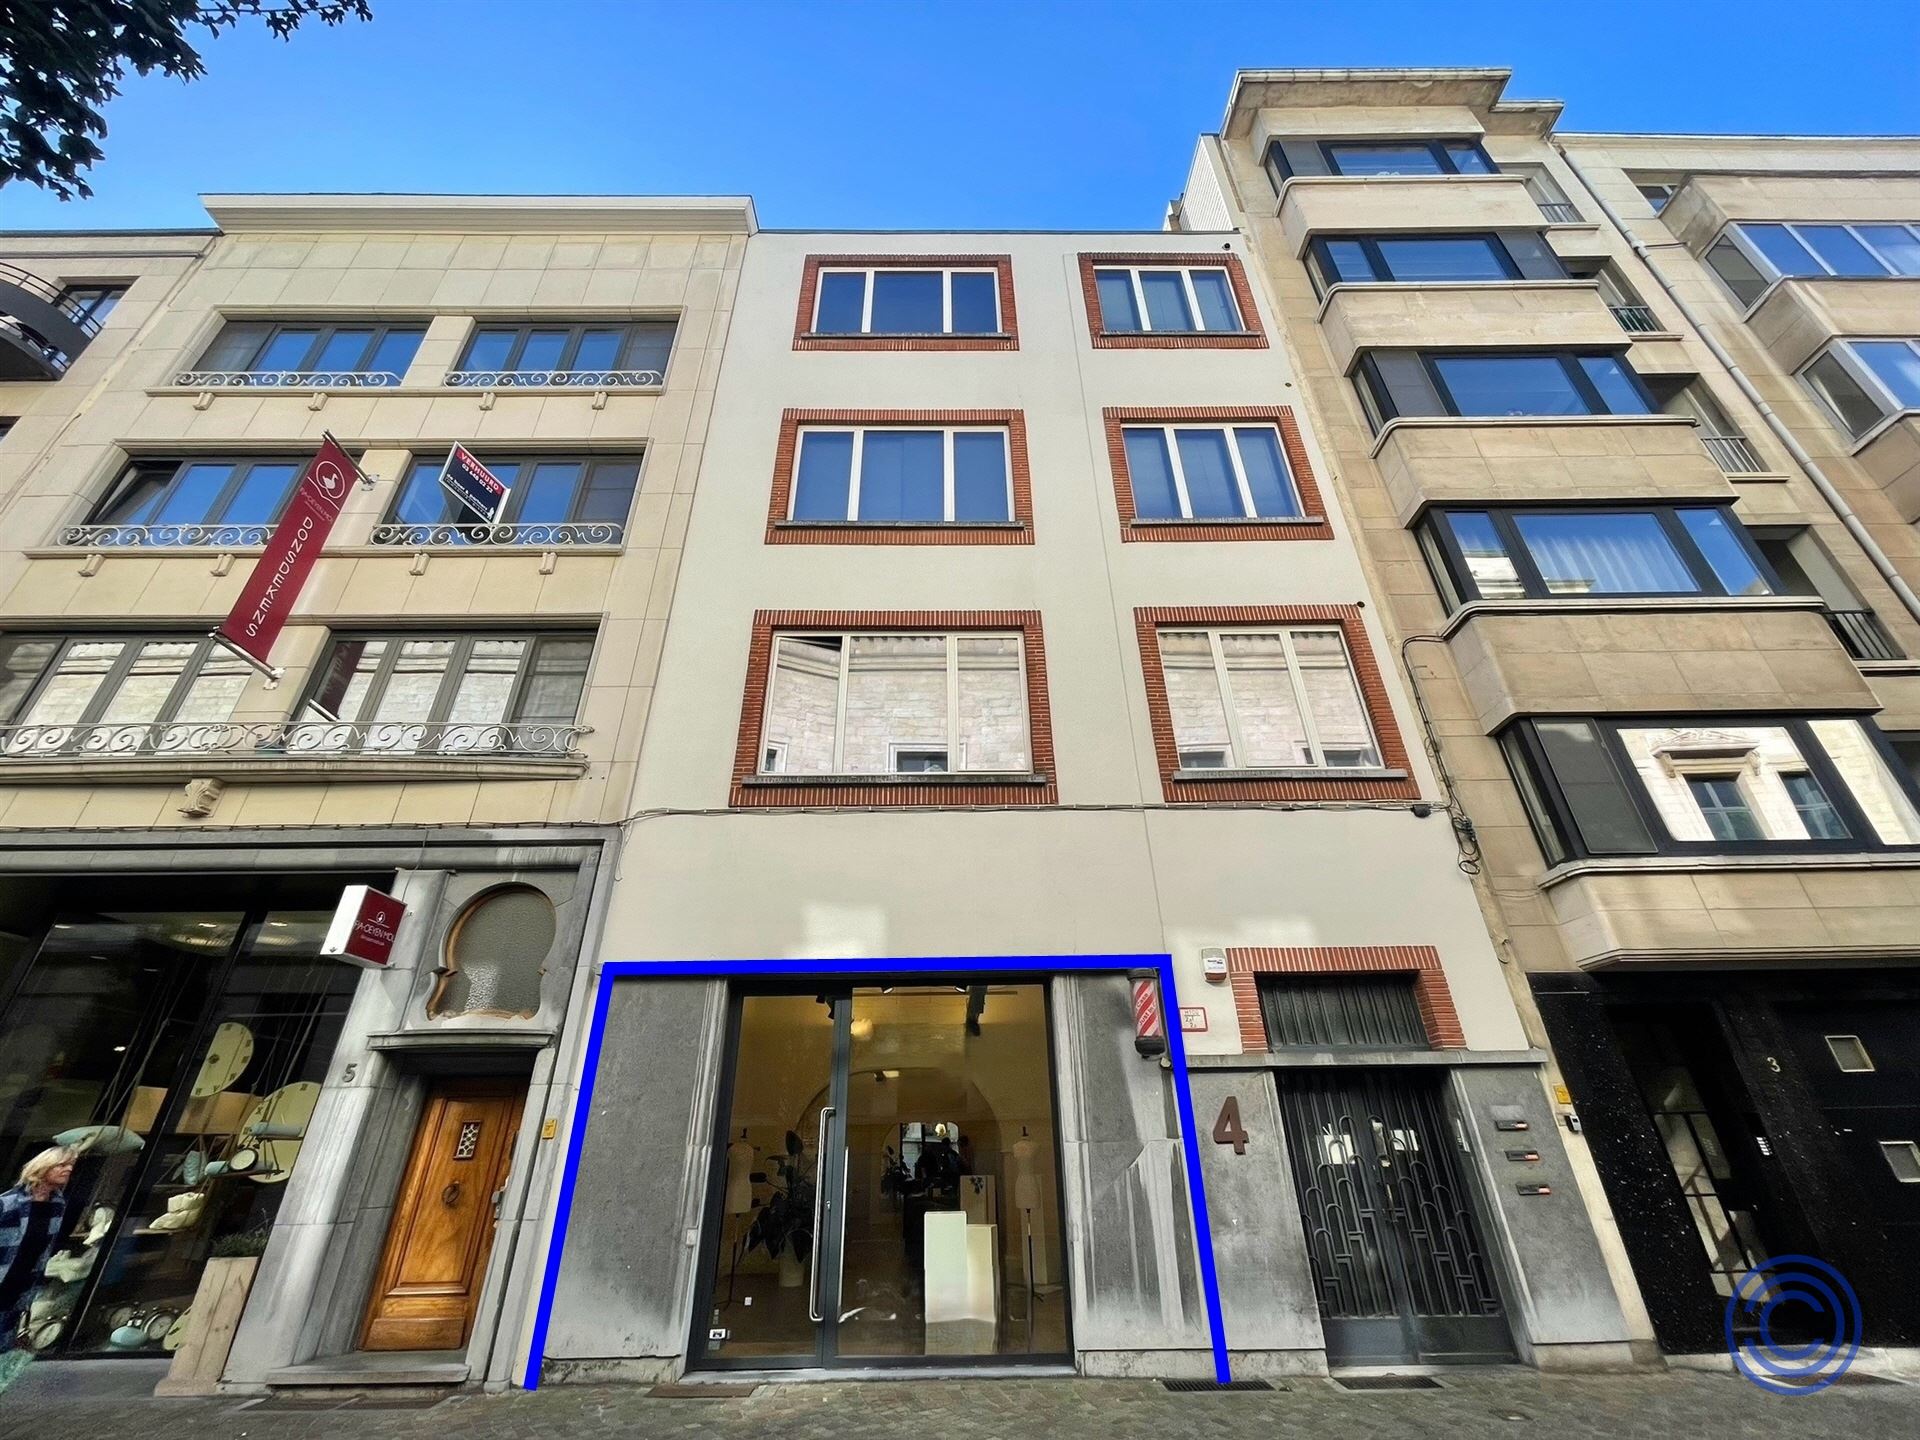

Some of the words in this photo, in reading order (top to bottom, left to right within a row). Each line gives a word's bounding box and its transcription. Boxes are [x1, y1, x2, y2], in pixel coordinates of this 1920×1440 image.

[461, 452, 499, 490] VERHUURD
[246, 516, 314, 637] DONSDEKENS
[342, 1063, 357, 1083] 5
[1767, 1057, 1780, 1072] 3
[1213, 1096, 1250, 1155] 4
